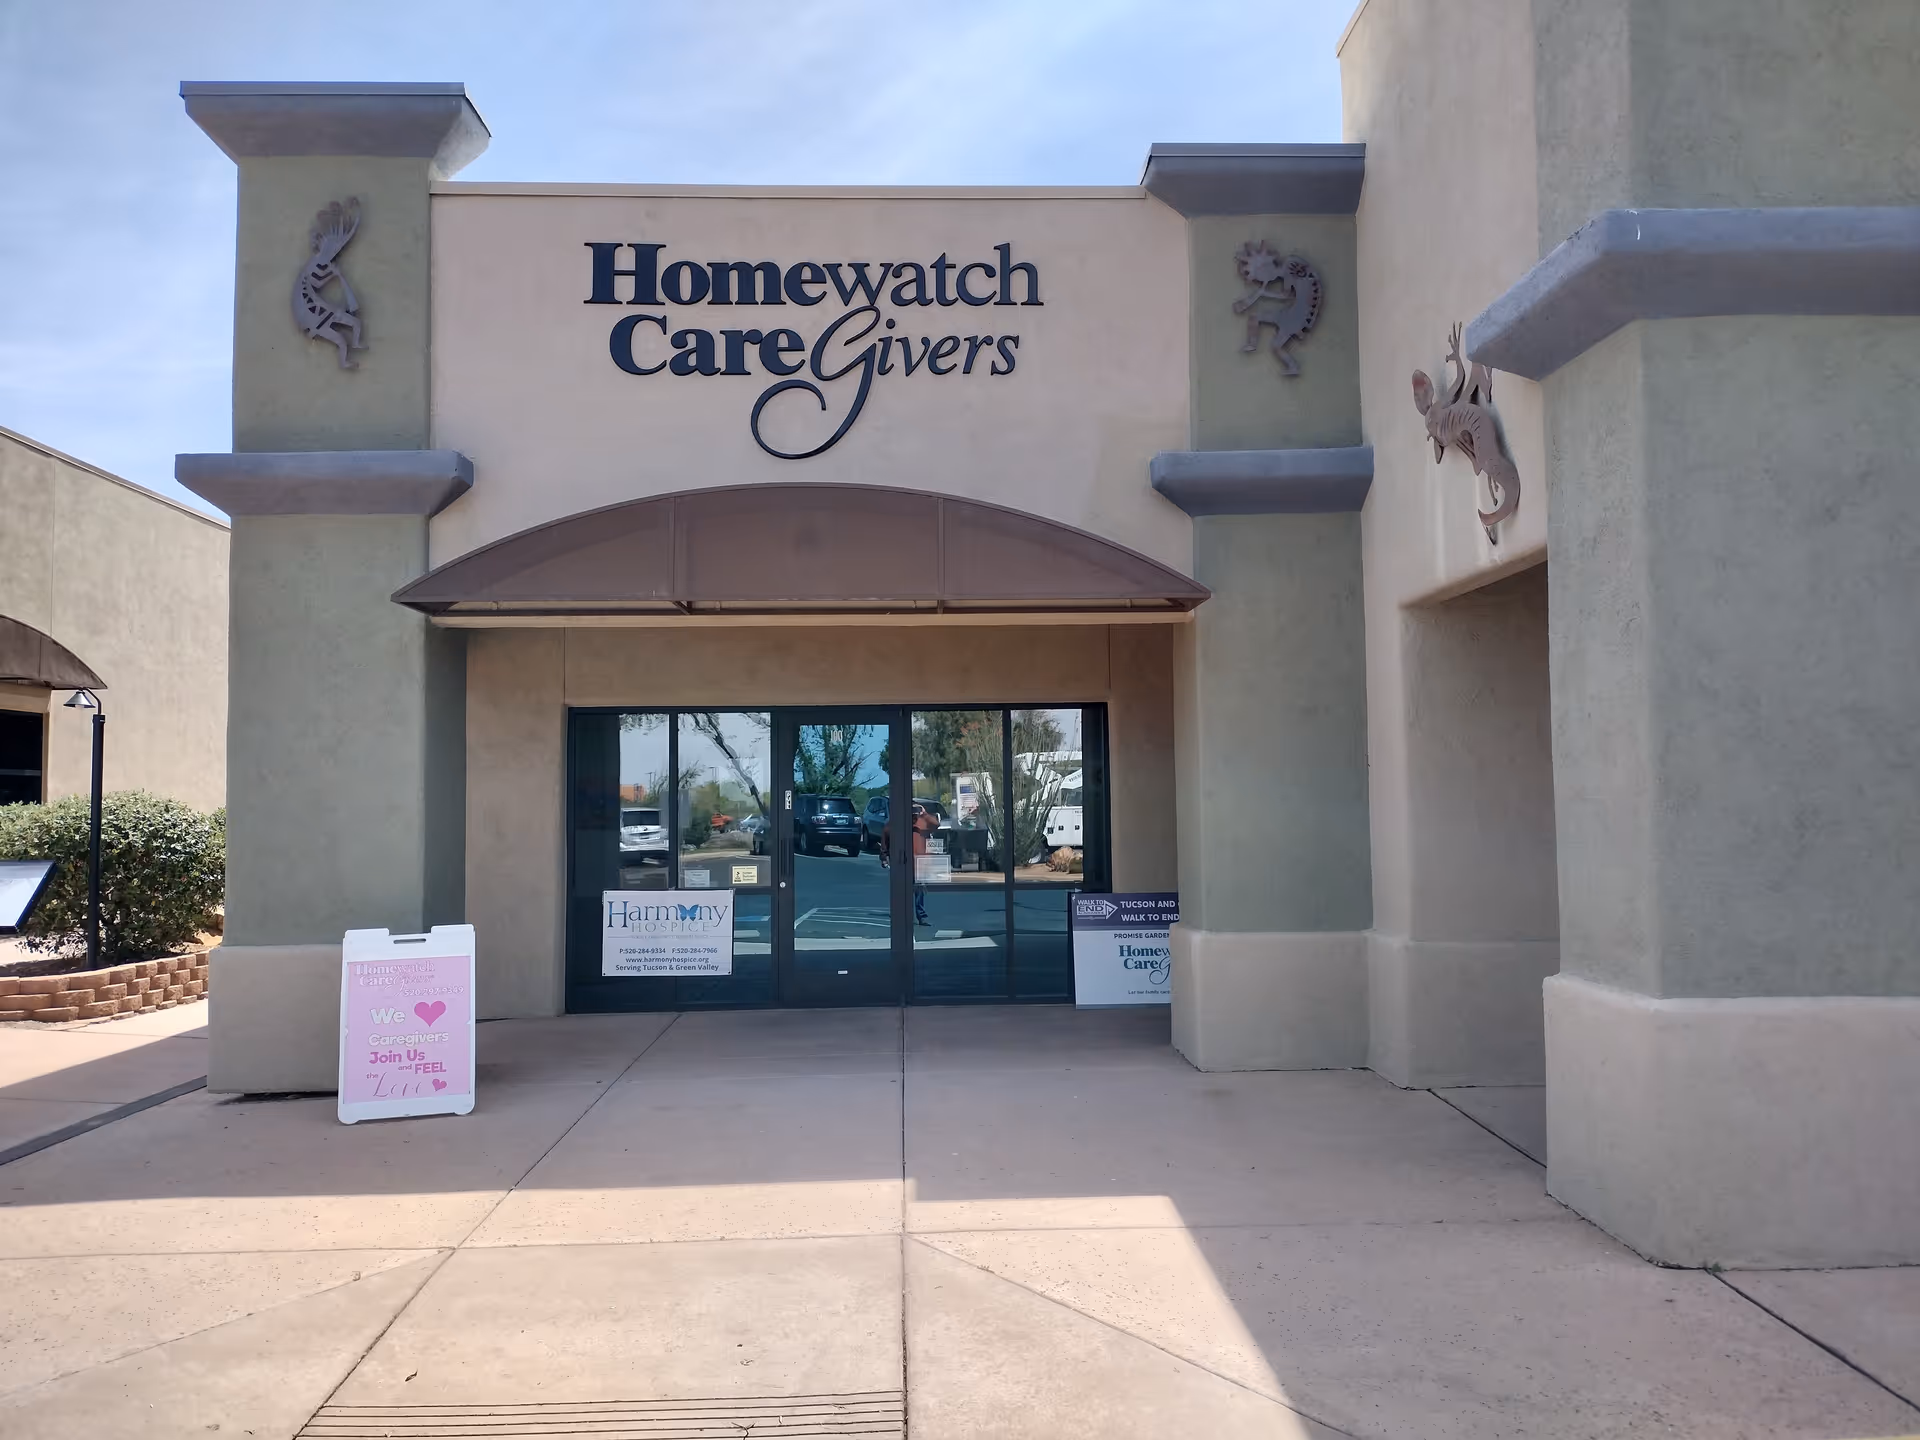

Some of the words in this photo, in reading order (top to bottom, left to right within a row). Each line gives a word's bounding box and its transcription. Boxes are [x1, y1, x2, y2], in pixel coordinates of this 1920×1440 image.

[583, 242, 1044, 306] Homewatch
[609, 305, 1019, 460] CareGivers
[1158, 900, 1176, 908] AND
[1162, 913, 1180, 921] END
[631, 922, 710, 933] HOSPICE
[625, 956, 710, 964] www.harmonyhospice.org
[615, 964, 642, 972] Serving
[370, 1007, 406, 1024] We
[368, 1030, 450, 1047] Caregivers
[369, 1050, 402, 1064] Join
[406, 1049, 426, 1061] Us
[397, 1063, 413, 1071] and
[414, 1061, 447, 1075] FEEL
[366, 1072, 379, 1080] the
